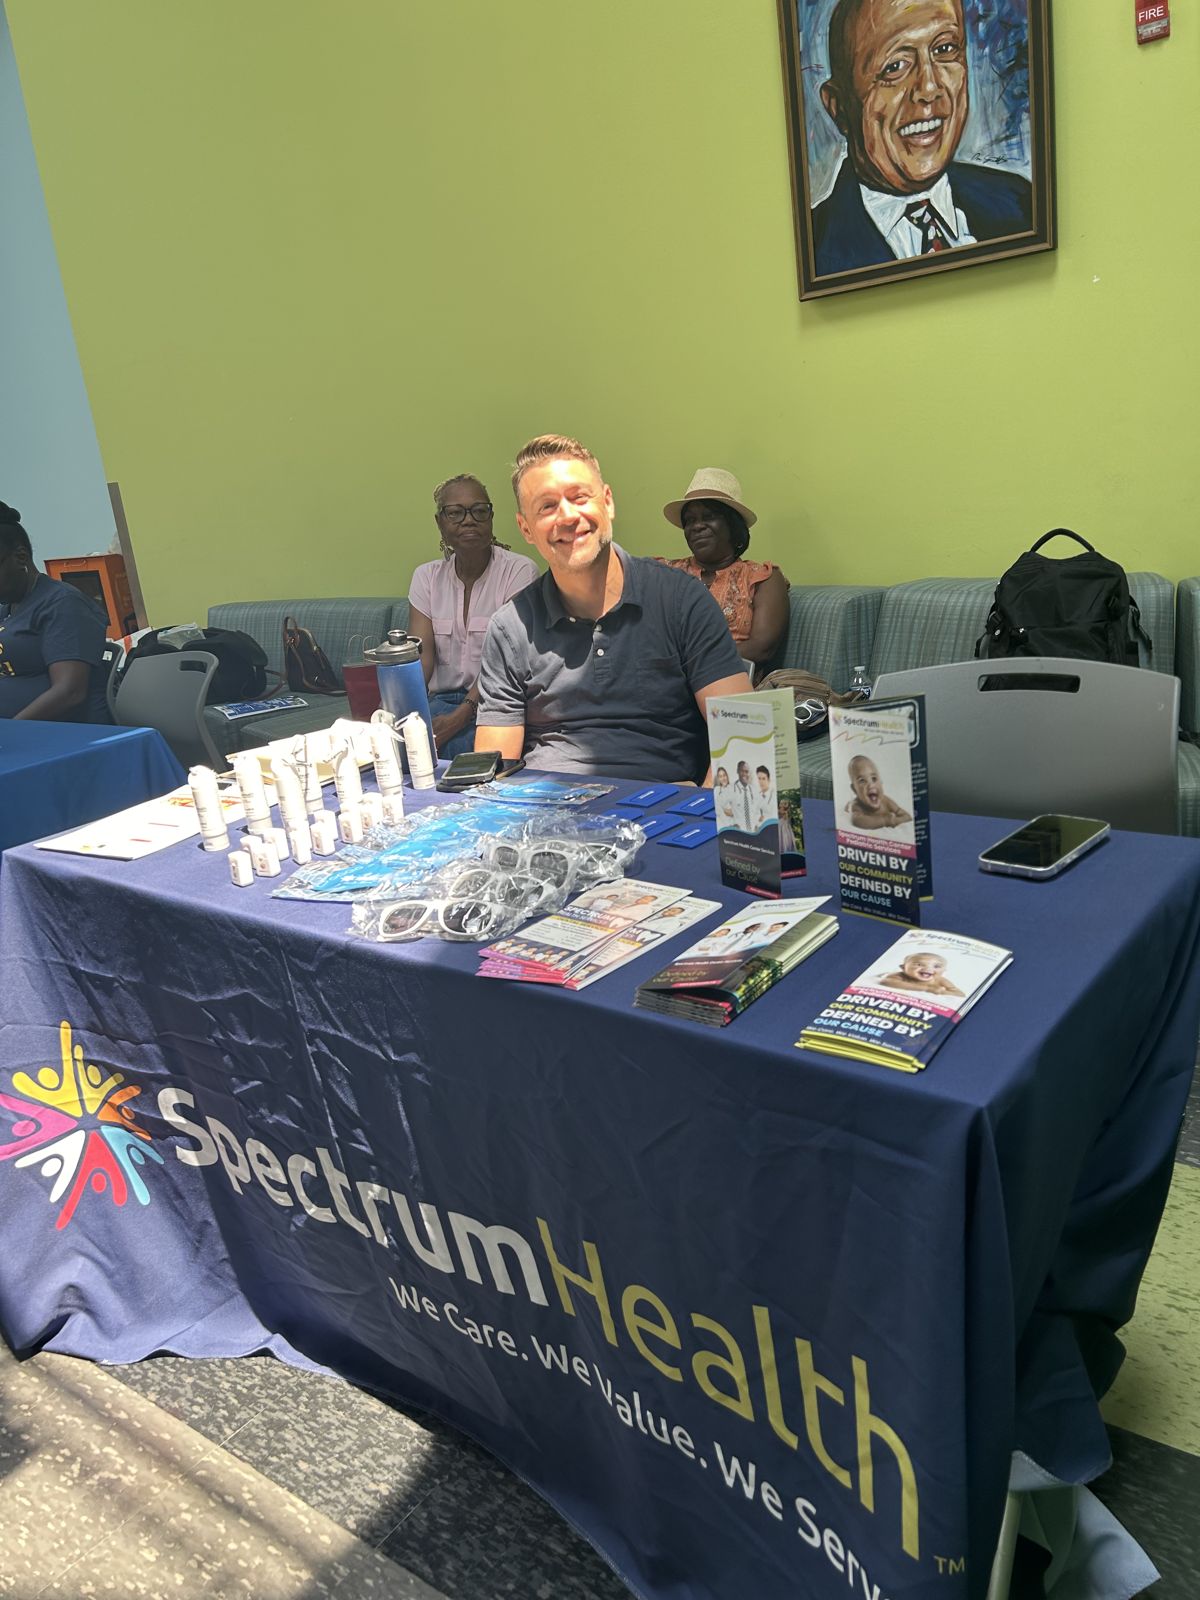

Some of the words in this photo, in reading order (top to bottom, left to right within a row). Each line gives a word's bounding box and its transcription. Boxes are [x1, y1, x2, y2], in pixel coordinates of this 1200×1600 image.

[1138, 5, 1165, 22] FIRE
[838, 845, 887, 868] DRIVEN
[889, 856, 909, 872] BY
[839, 861, 857, 873] OUR
[857, 866, 913, 885] COMMUNITY
[840, 873, 892, 895] DEFINED
[893, 885, 912, 900] BY
[841, 888, 860, 900] OUR
[860, 893, 892, 908] CAUSE
[829, 1002, 855, 1011] OUR
[855, 1006, 933, 1030] COMMUNITY
[836, 993, 907, 1014] DRIVEN
[907, 1007, 937, 1021] BY
[813, 1018, 841, 1028] OUR
[841, 1022, 885, 1038] CAUSE
[820, 1008, 894, 1030] DEFINED
[894, 1024, 923, 1038] BY
[388, 1277, 440, 1321] We
[443, 1302, 529, 1361] Care.
[531, 1335, 592, 1387] We
[593, 1363, 708, 1468] Value.
[713, 1441, 783, 1521] We
[795, 1497, 889, 1600] Serv
[934, 1556, 965, 1575] TM
